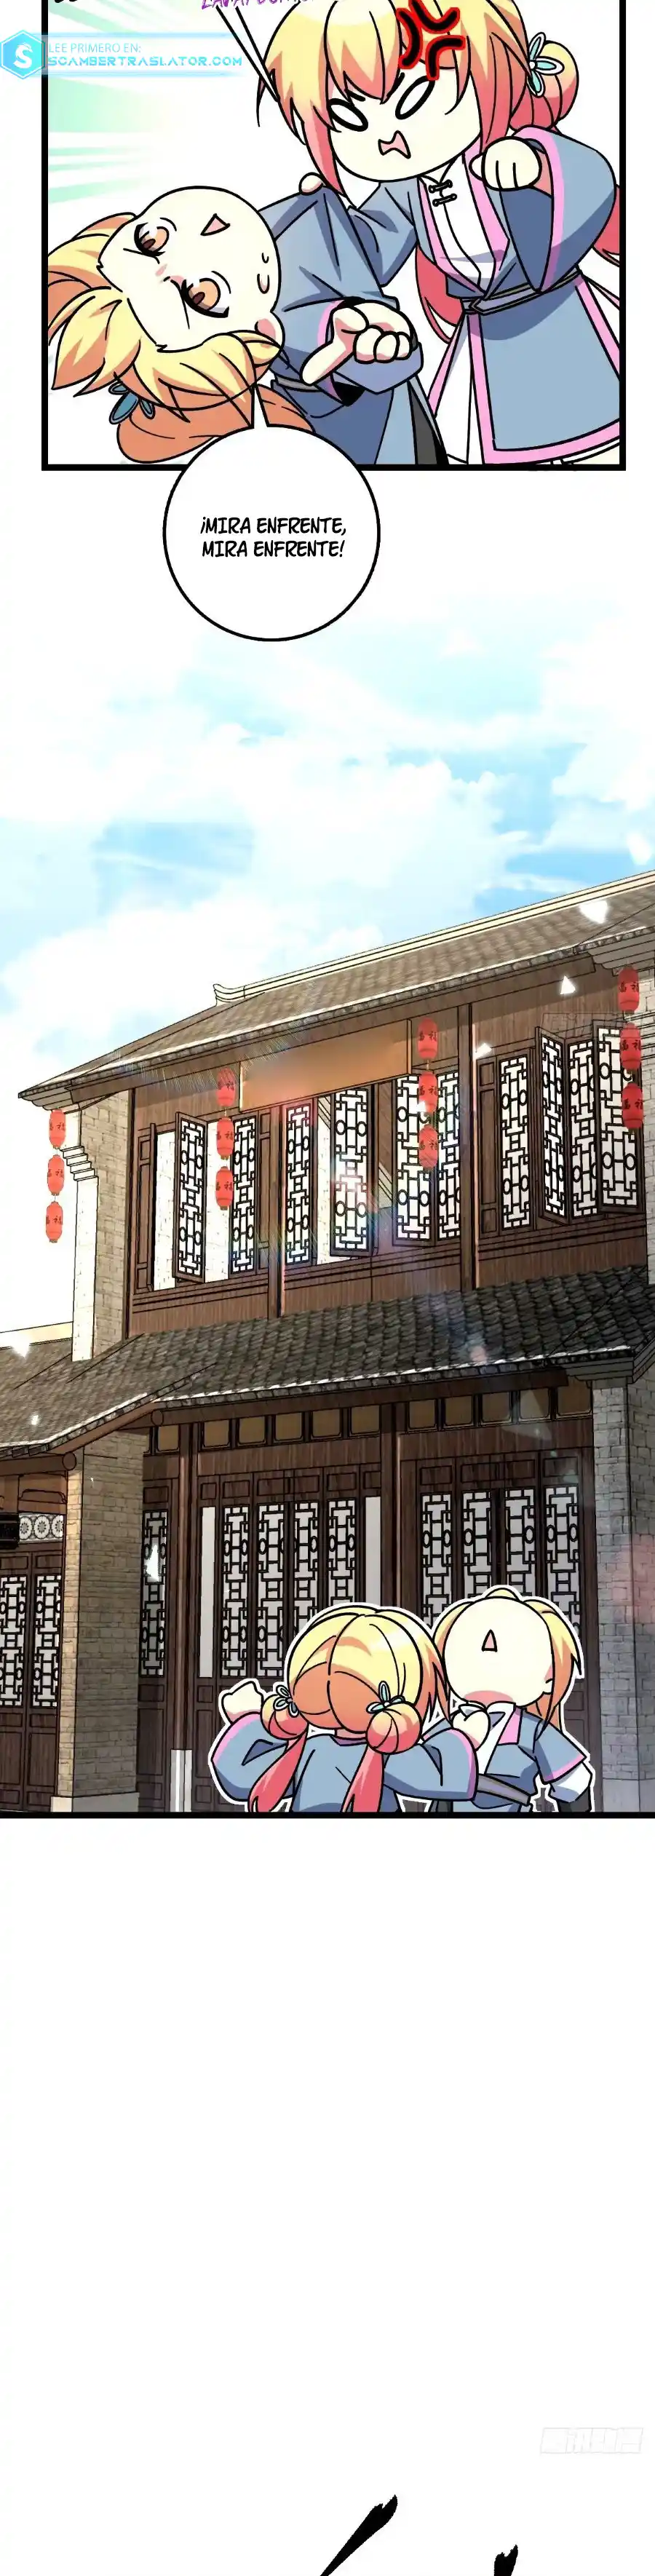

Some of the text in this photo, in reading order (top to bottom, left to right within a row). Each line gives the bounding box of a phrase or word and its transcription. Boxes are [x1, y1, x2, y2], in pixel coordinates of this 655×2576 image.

[200, 516, 346, 536] ¡MIRA ENFRENTE,
[202, 539, 345, 558] MIRA ENFRENTE!
